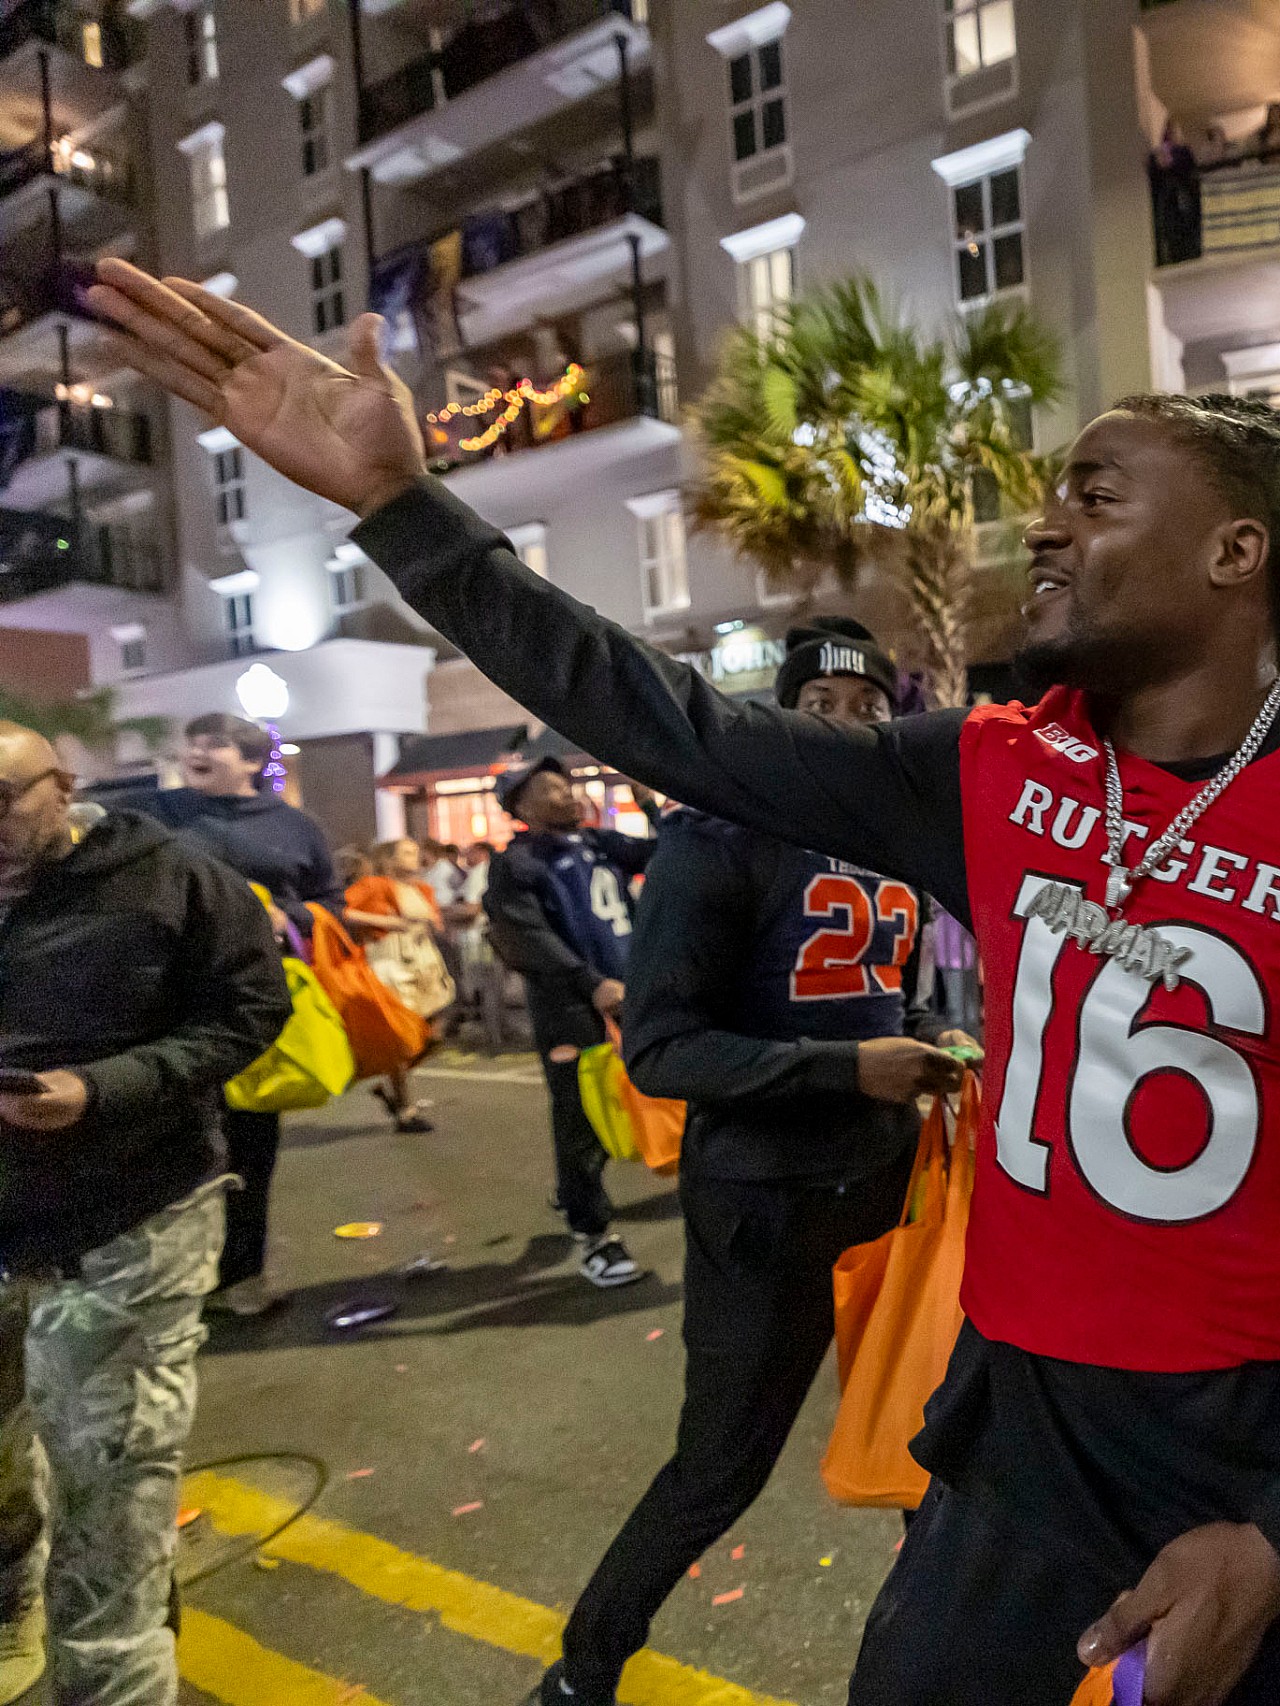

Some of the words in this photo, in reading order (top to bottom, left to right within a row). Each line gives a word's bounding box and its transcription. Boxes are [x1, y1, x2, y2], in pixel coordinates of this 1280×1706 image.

[1032, 722, 1099, 763] BIG
[589, 865, 633, 938] 4
[789, 873, 919, 1002] 23
[993, 872, 1268, 1225] 16
